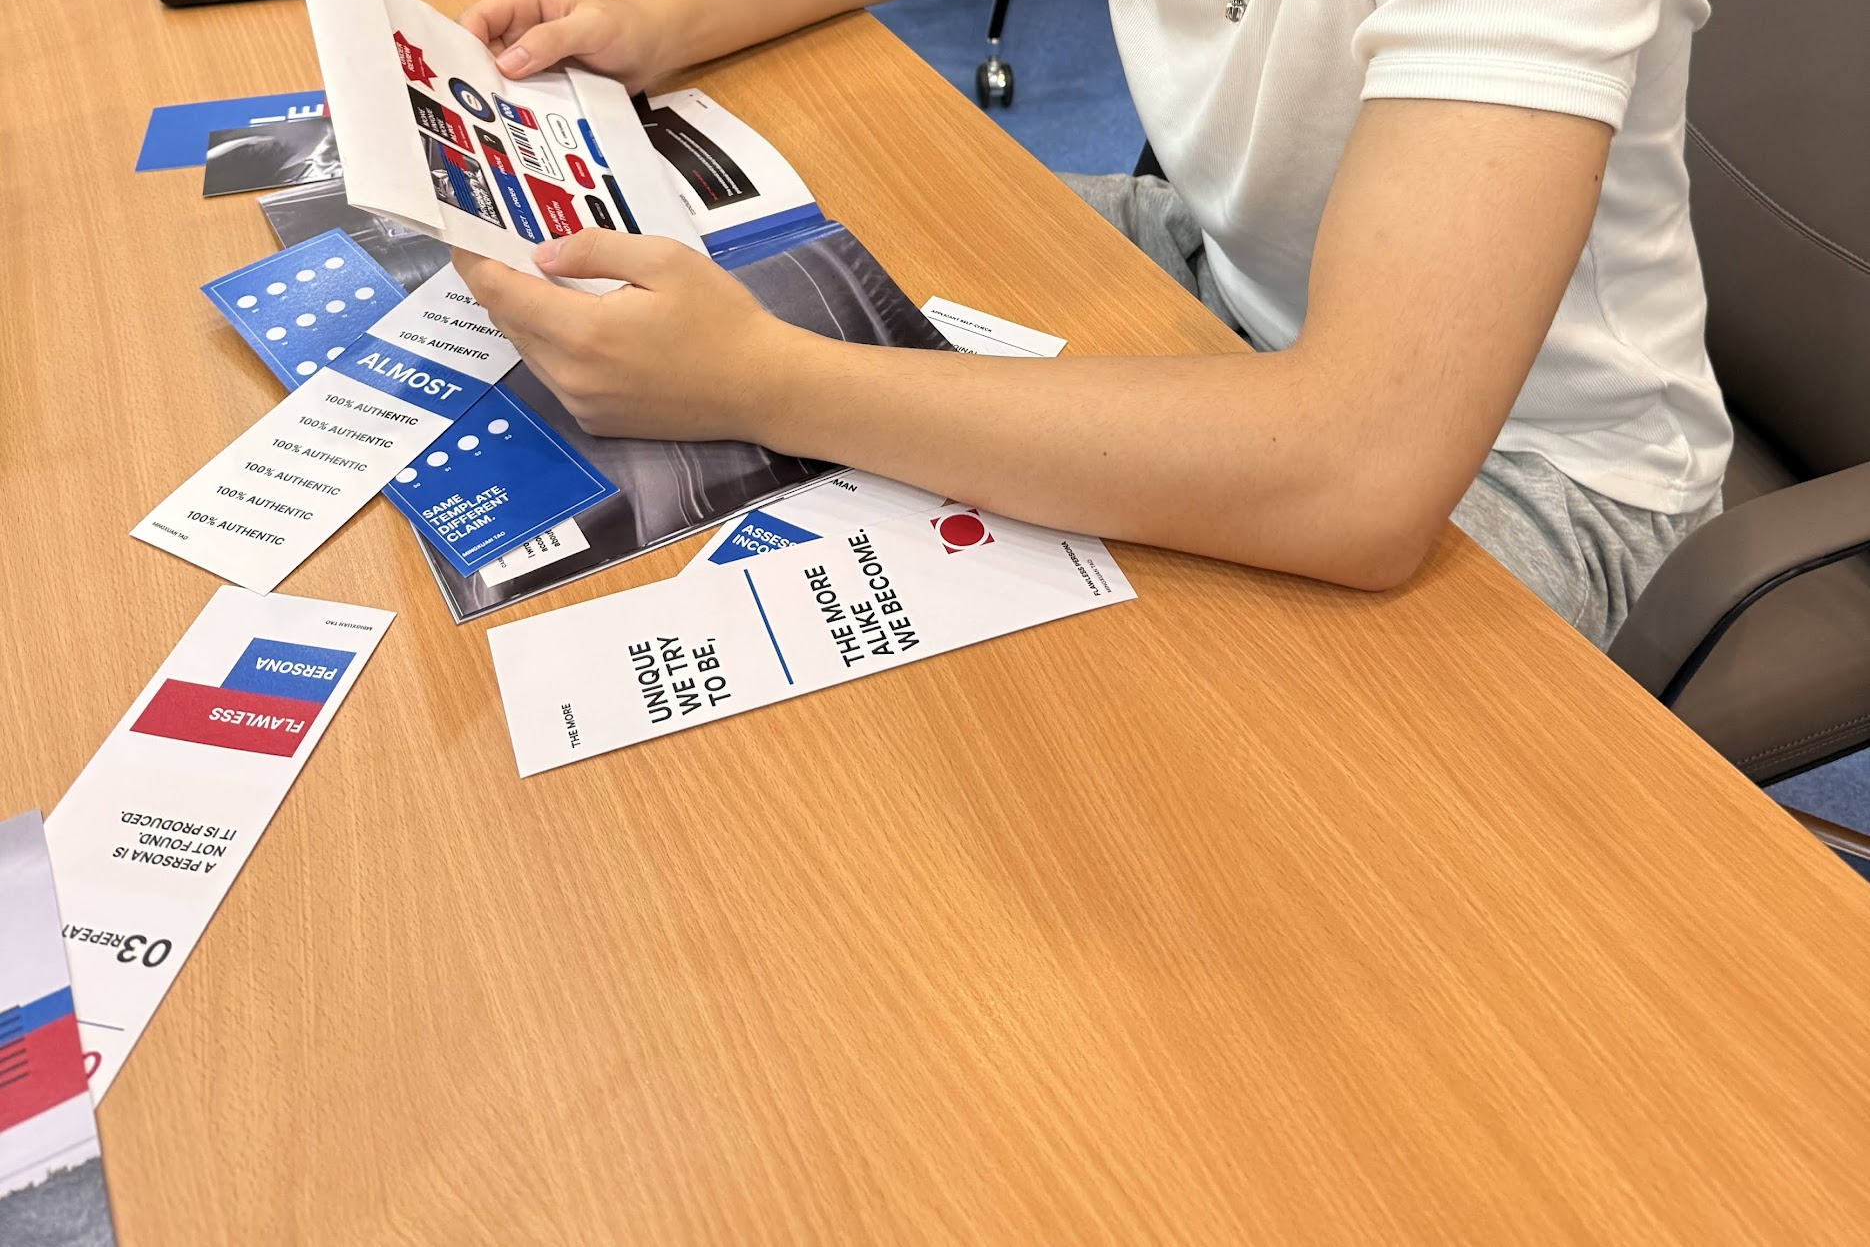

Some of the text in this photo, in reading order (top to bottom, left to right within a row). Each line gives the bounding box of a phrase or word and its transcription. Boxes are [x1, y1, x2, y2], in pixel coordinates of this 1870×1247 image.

[507, 186, 521, 208] ORDER
[552, 200, 567, 224] TRUTH
[519, 215, 535, 240] SELECT
[546, 204, 563, 232] CLARITY
[445, 292, 473, 304] 100%
[422, 311, 450, 324] 100%
[931, 309, 993, 333] APPLICANT SELF-CHECK
[399, 331, 490, 361] 100% AUTHENTIC
[356, 353, 463, 401] ALMOST
[325, 394, 419, 426] 100% AUTHENTIC
[299, 416, 394, 449] 100% AUTHENTIC
[272, 438, 368, 472] 100% AUTHENTIC
[244, 461, 341, 496] 100% AUTHENTIC
[216, 485, 314, 521] 100% AUTHENTIC
[422, 493, 464, 519] SAME
[429, 485, 506, 526] TEMPLATE.
[437, 493, 510, 535] DIFFERENT
[177, 531, 189, 541] TAO
[187, 510, 285, 546] 100% AUTHENTIC
[446, 516, 496, 543] CLAIM.
[732, 534, 776, 554] INCO
[461, 531, 506, 558] MINGXUAN TAO
[1061, 541, 1101, 597] FLAWLESS PERSONA
[1087, 559, 1112, 593] MINGXUAN TAO
[847, 528, 920, 652] WE BECOME.
[804, 565, 865, 668] THE MORE
[850, 601, 895, 655] ALIKE
[255, 657, 339, 681] PERSONA
[628, 641, 673, 724] UNIQUE
[656, 636, 702, 716] WE TRY
[691, 638, 731, 707] TO BE,
[208, 707, 305, 734] FLAWLESS
[561, 702, 581, 749] THE MORE
[120, 810, 237, 841] IT IS PRODUCED.
[112, 846, 217, 874] A PERSONA IS
[138, 832, 227, 858] NOT FOUND.
[116, 934, 173, 968] 03
